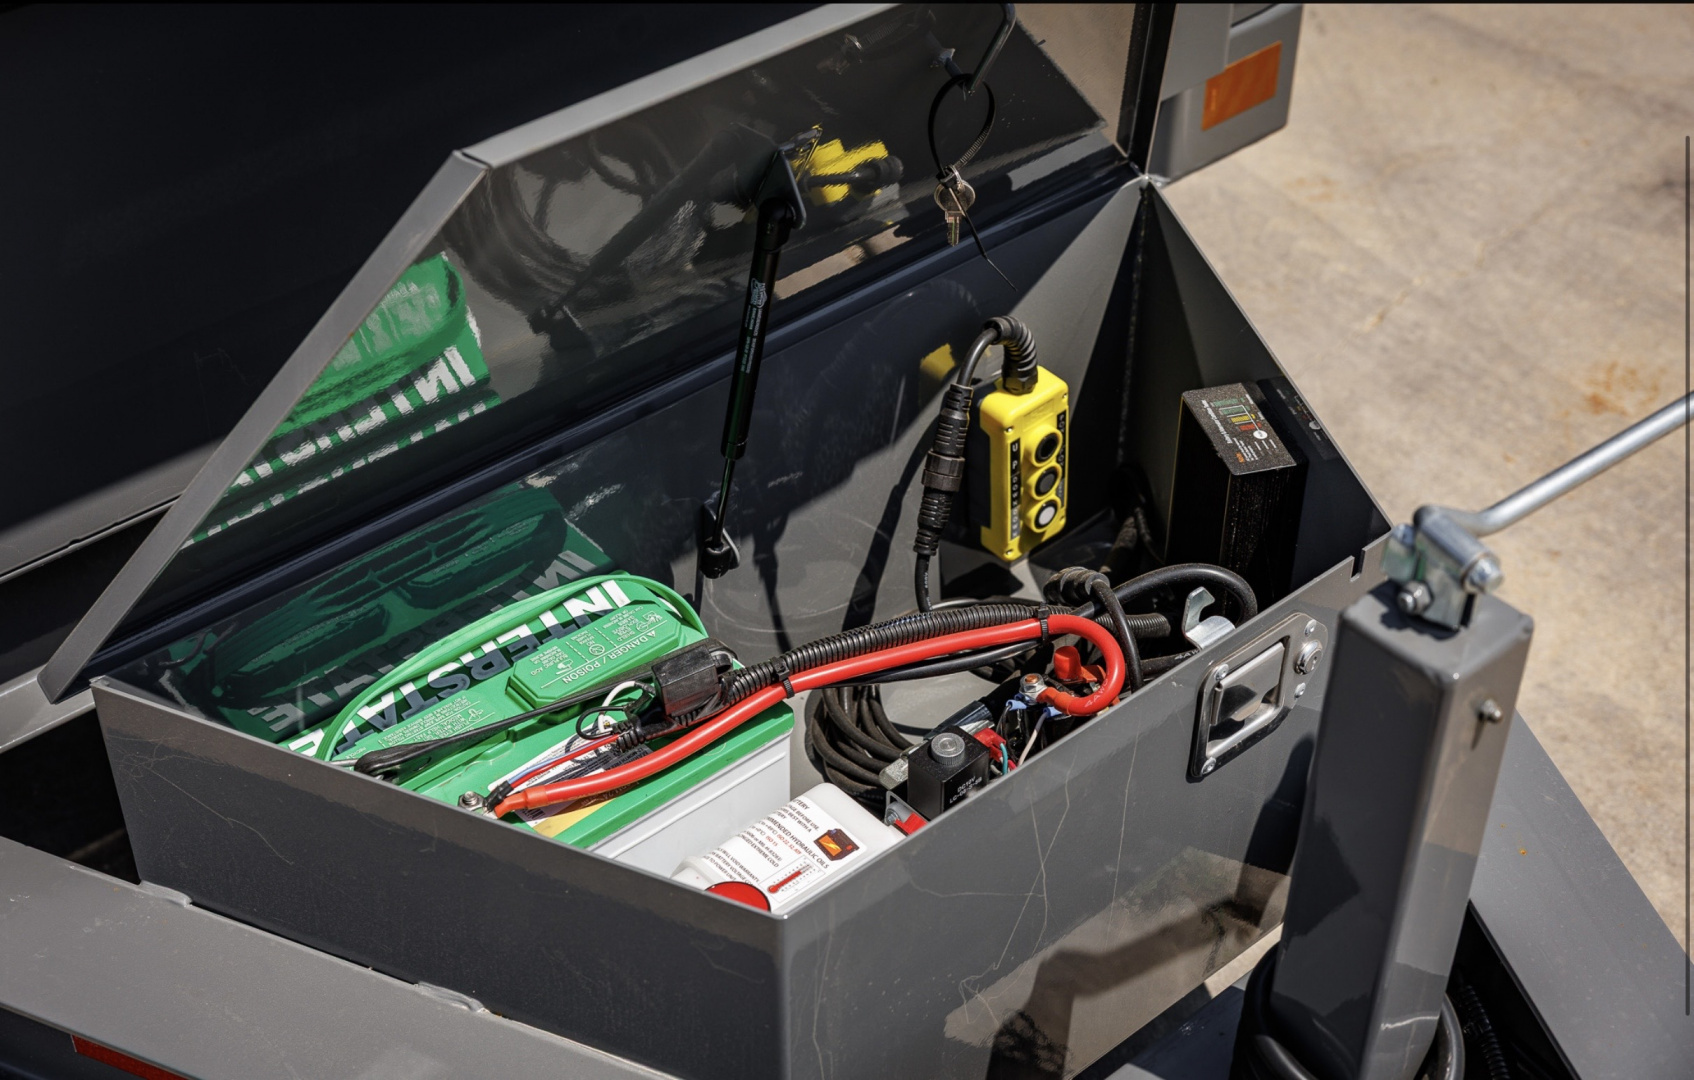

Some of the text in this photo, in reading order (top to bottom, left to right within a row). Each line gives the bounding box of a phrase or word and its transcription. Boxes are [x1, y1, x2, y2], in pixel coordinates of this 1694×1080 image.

[562, 636, 648, 684] DANGER / POISON
[790, 834, 819, 859] HYDRAULIC
[816, 857, 830, 869] OILS
